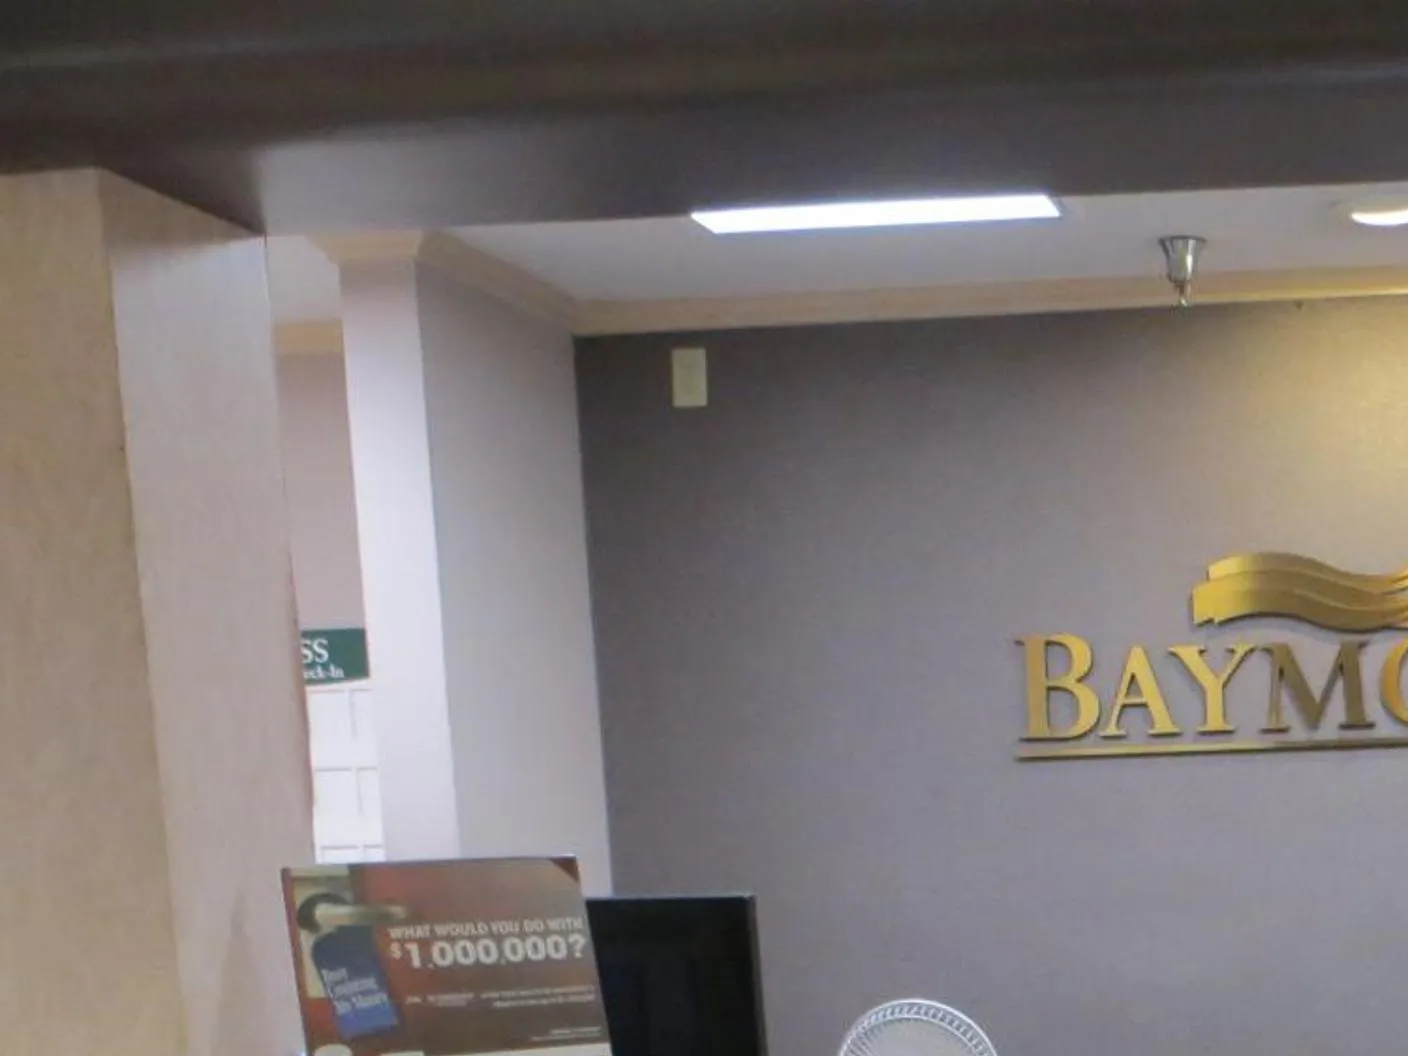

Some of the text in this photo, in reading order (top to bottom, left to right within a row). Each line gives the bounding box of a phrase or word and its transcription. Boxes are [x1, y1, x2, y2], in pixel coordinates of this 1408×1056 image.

[388, 916, 584, 940] WHAT WOULD YOU DO WITH
